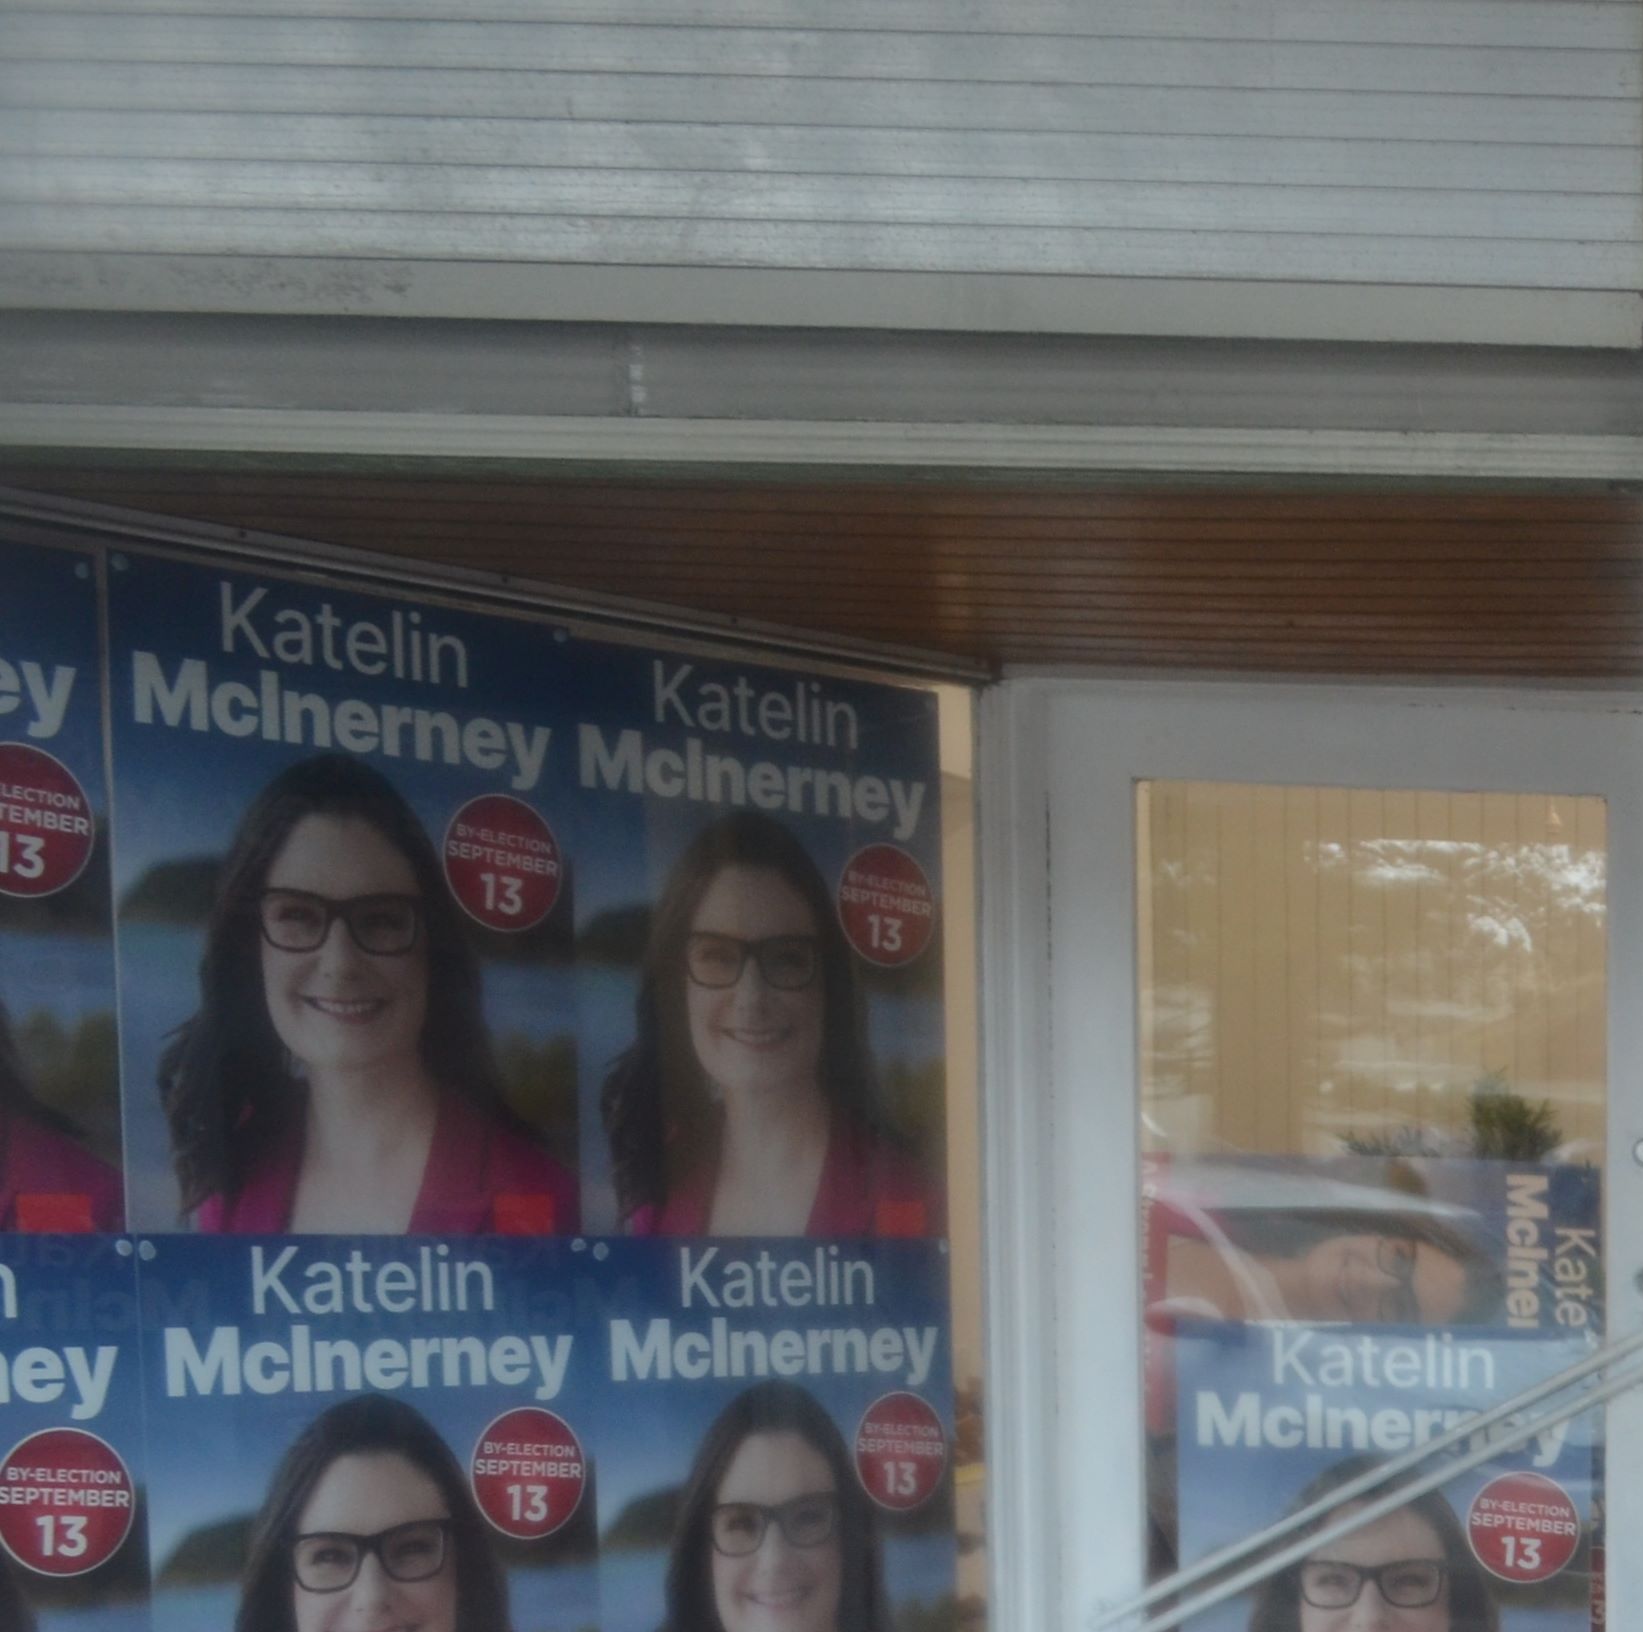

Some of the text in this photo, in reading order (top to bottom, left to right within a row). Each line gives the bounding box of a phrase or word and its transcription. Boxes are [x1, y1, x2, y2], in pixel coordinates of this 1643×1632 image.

[220, 581, 468, 688] Katelin
[132, 650, 552, 791] McInerney
[653, 660, 859, 750] Katelin
[579, 722, 926, 840] McInerney
[456, 823, 552, 855] BY-ELECTION
[447, 841, 558, 876] SEPTEMBER
[480, 872, 523, 915] 13
[841, 884, 933, 917] SEPTEMBER
[847, 869, 926, 897] BY-ELECTION
[867, 913, 902, 951] 13
[251, 1243, 494, 1315] Katelin
[680, 1245, 875, 1308] Katelin
[163, 1324, 574, 1400] McInerney
[610, 1317, 939, 1386] McInerney
[1273, 1329, 1496, 1390] Katelin
[856, 1437, 945, 1456] SEPTEMBER
[864, 1423, 939, 1438] BY-ELECTION
[483, 1442, 576, 1458] BY-ELECTION
[7, 1467, 122, 1485] BY-ELECTION
[474, 1459, 582, 1479] SEPTEMBER
[884, 1462, 917, 1495] 13
[0, 1487, 130, 1508] SEPTEMBER
[506, 1484, 548, 1522] 13
[1480, 1498, 1571, 1518] BY-ELECTION
[36, 1516, 88, 1557] 13
[1471, 1513, 1576, 1537] SEPTEMBER
[1501, 1538, 1541, 1570] 13
